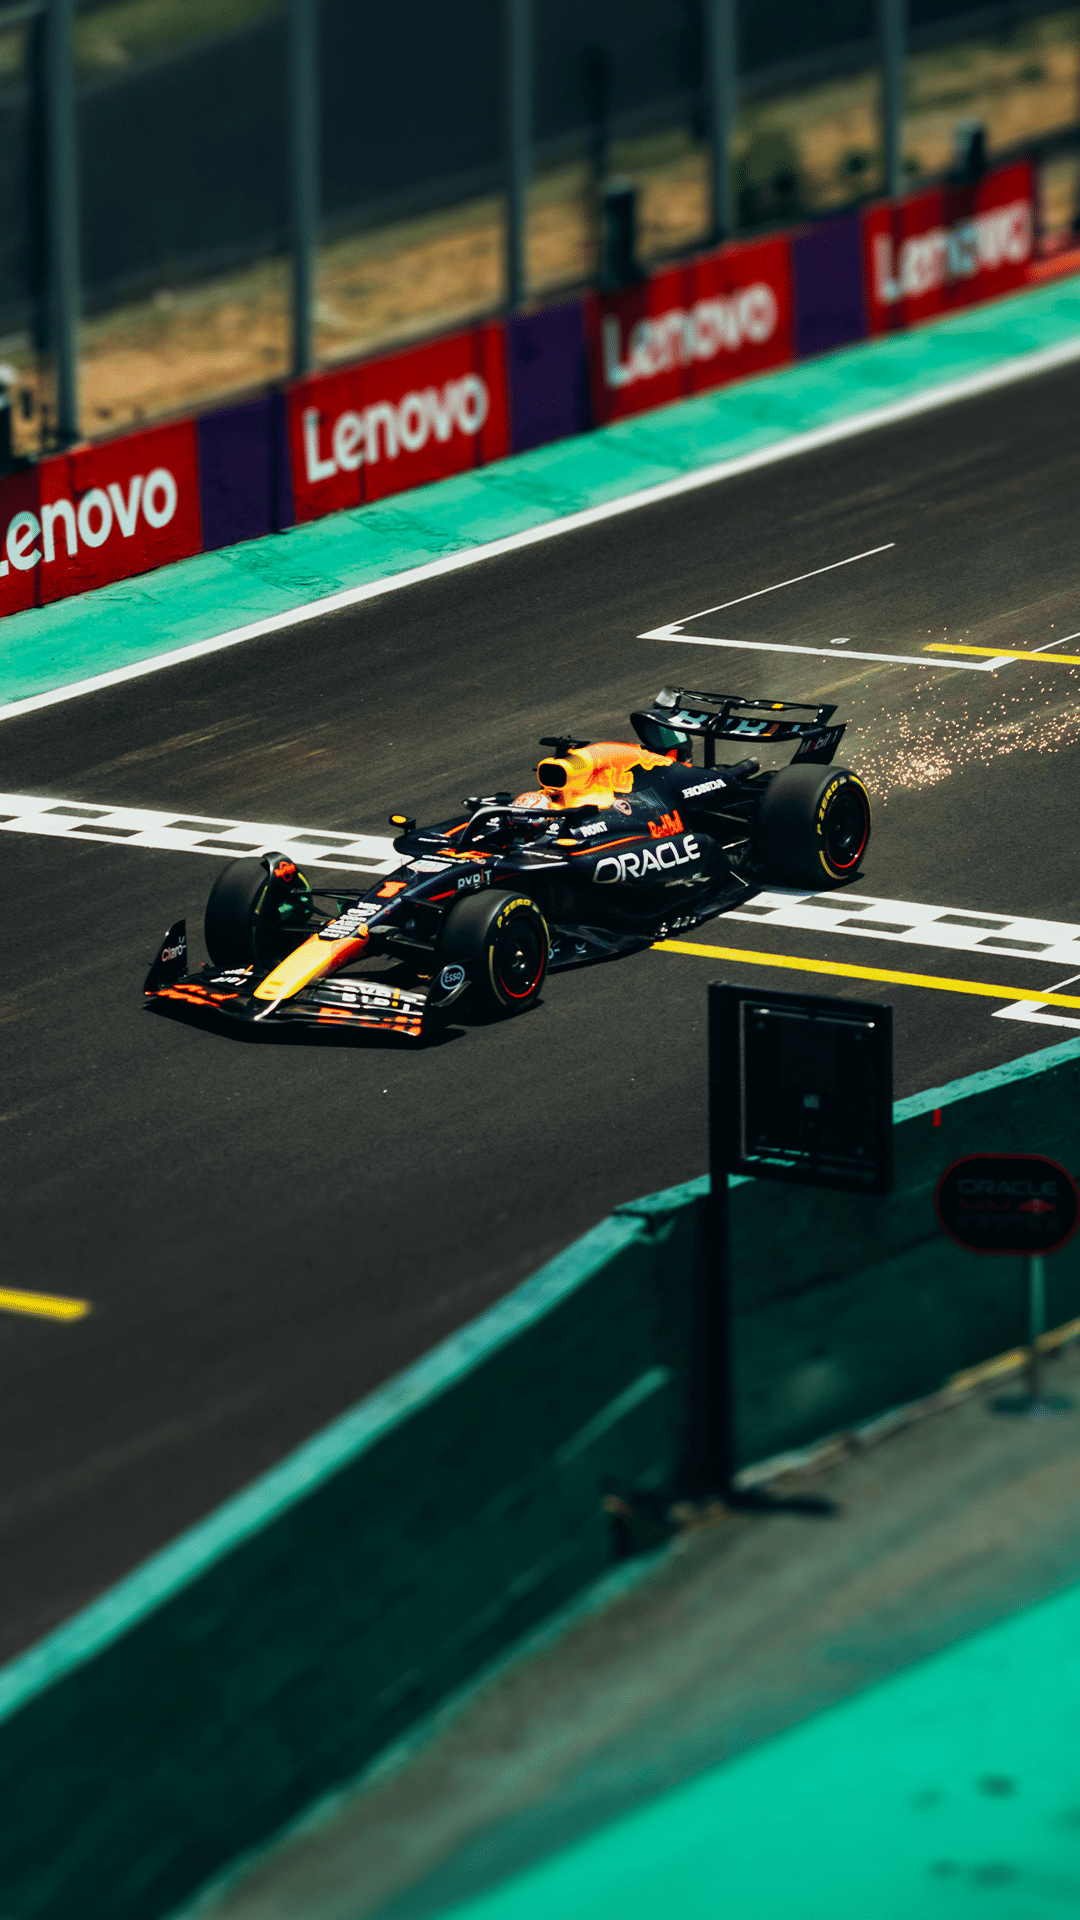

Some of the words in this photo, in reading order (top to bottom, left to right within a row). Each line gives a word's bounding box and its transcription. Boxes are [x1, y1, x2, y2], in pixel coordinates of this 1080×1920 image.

[874, 201, 1033, 306] Lenovo
[604, 283, 779, 390] Lenovo
[304, 373, 490, 484] Lenovo
[0, 467, 178, 577] enovo
[681, 778, 728, 799] HONDA
[592, 834, 701, 884] ORACLE
[376, 881, 408, 898] 1
[161, 944, 184, 962] Claro
[956, 1178, 1059, 1197] ORACLE
